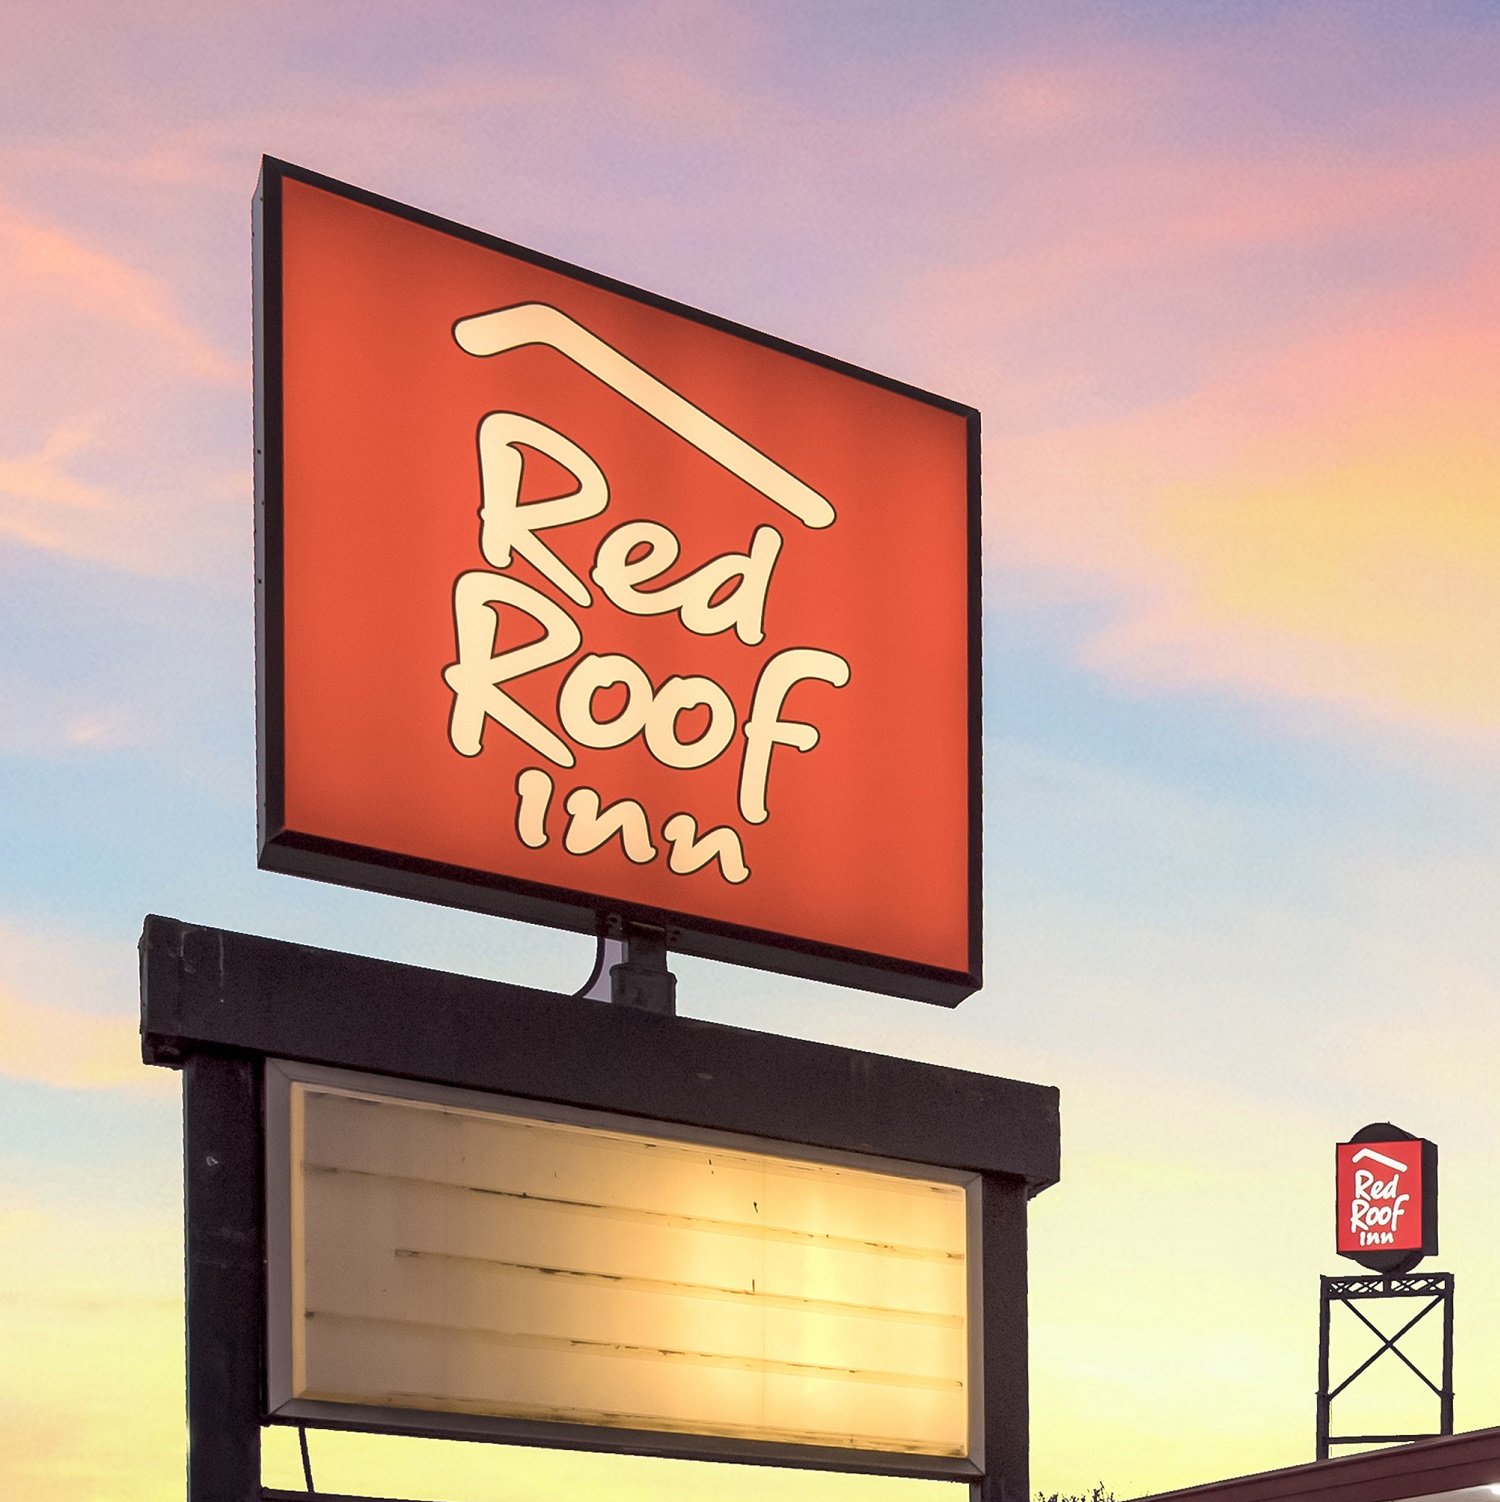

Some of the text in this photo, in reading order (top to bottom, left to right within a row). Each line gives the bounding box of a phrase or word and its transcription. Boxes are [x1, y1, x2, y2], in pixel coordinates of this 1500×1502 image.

[477, 410, 784, 647] Red
[443, 569, 852, 825] Roof
[1350, 1194, 1410, 1233] Roof
[1355, 1169, 1400, 1201] Red
